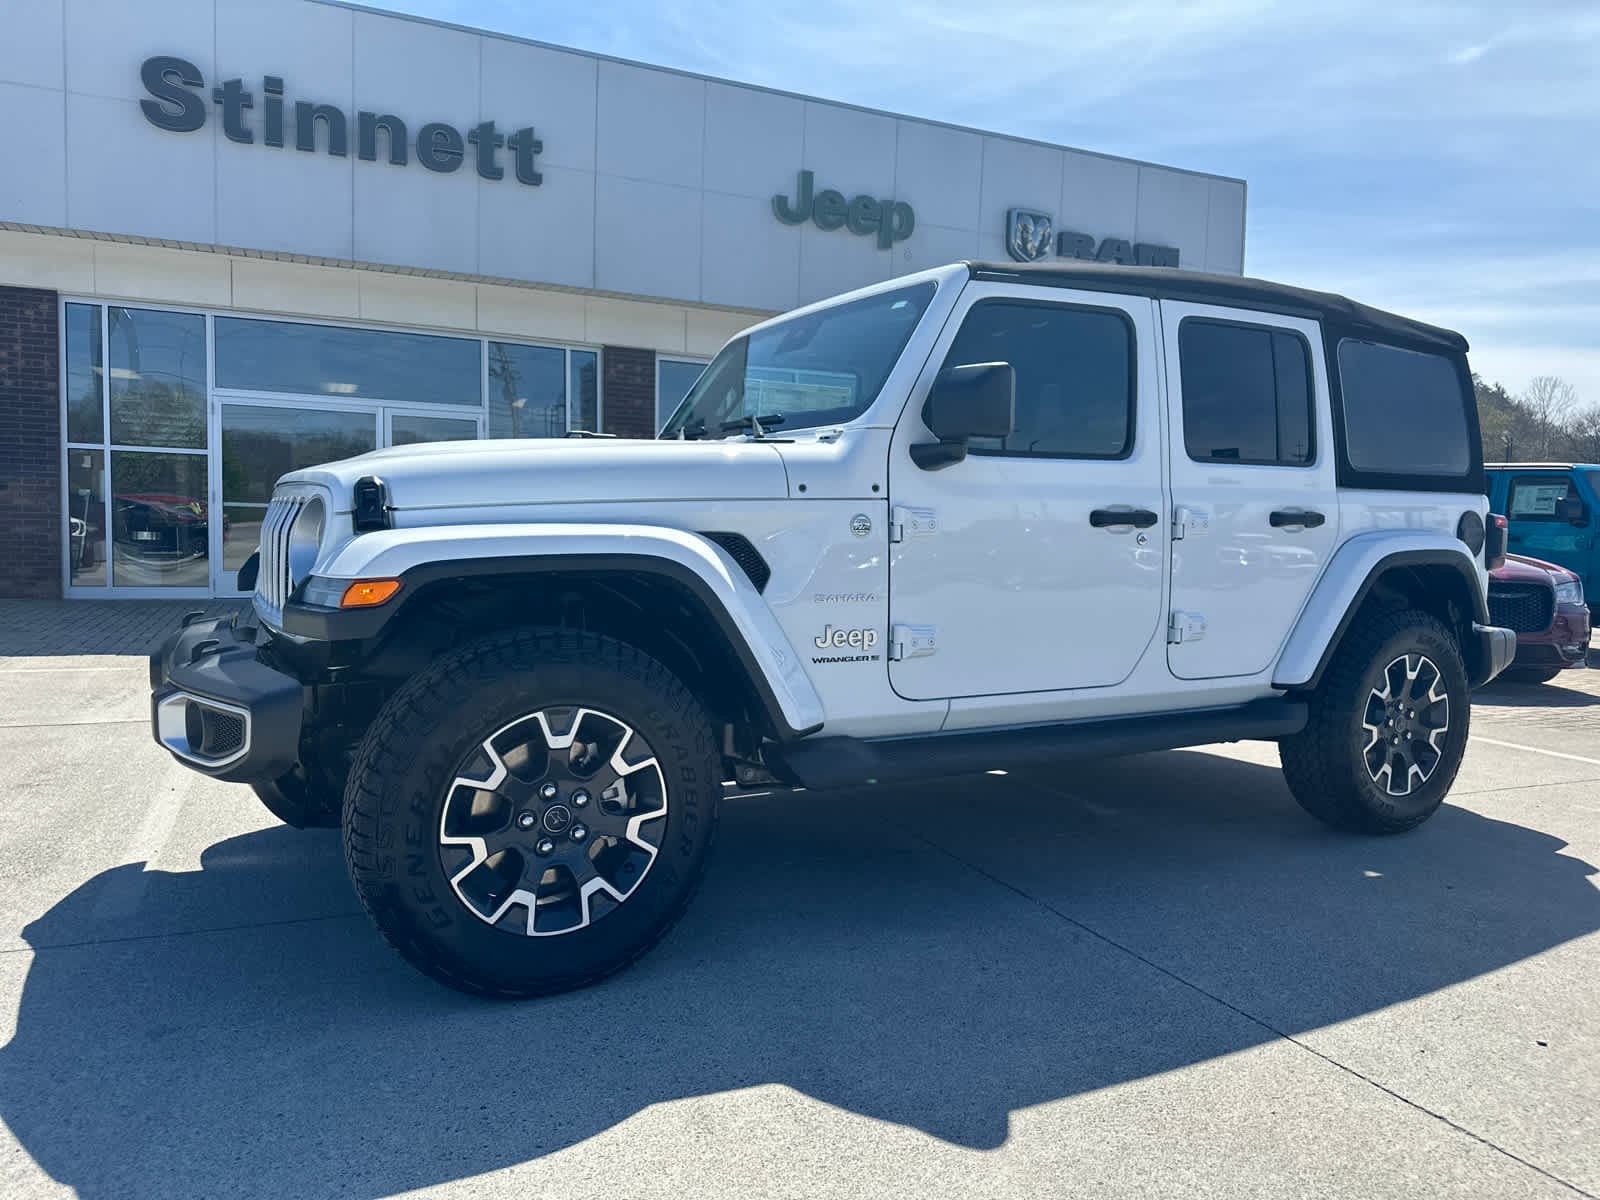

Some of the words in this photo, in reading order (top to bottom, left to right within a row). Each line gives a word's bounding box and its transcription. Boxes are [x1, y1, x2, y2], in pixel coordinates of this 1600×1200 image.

[139, 55, 543, 186] Stinnett
[771, 169, 915, 250] Jeep
[1056, 230, 1180, 269] RAM
[814, 592, 878, 603] SAHARA
[814, 624, 878, 652] Jeep
[811, 655, 869, 664] WRANGLER
